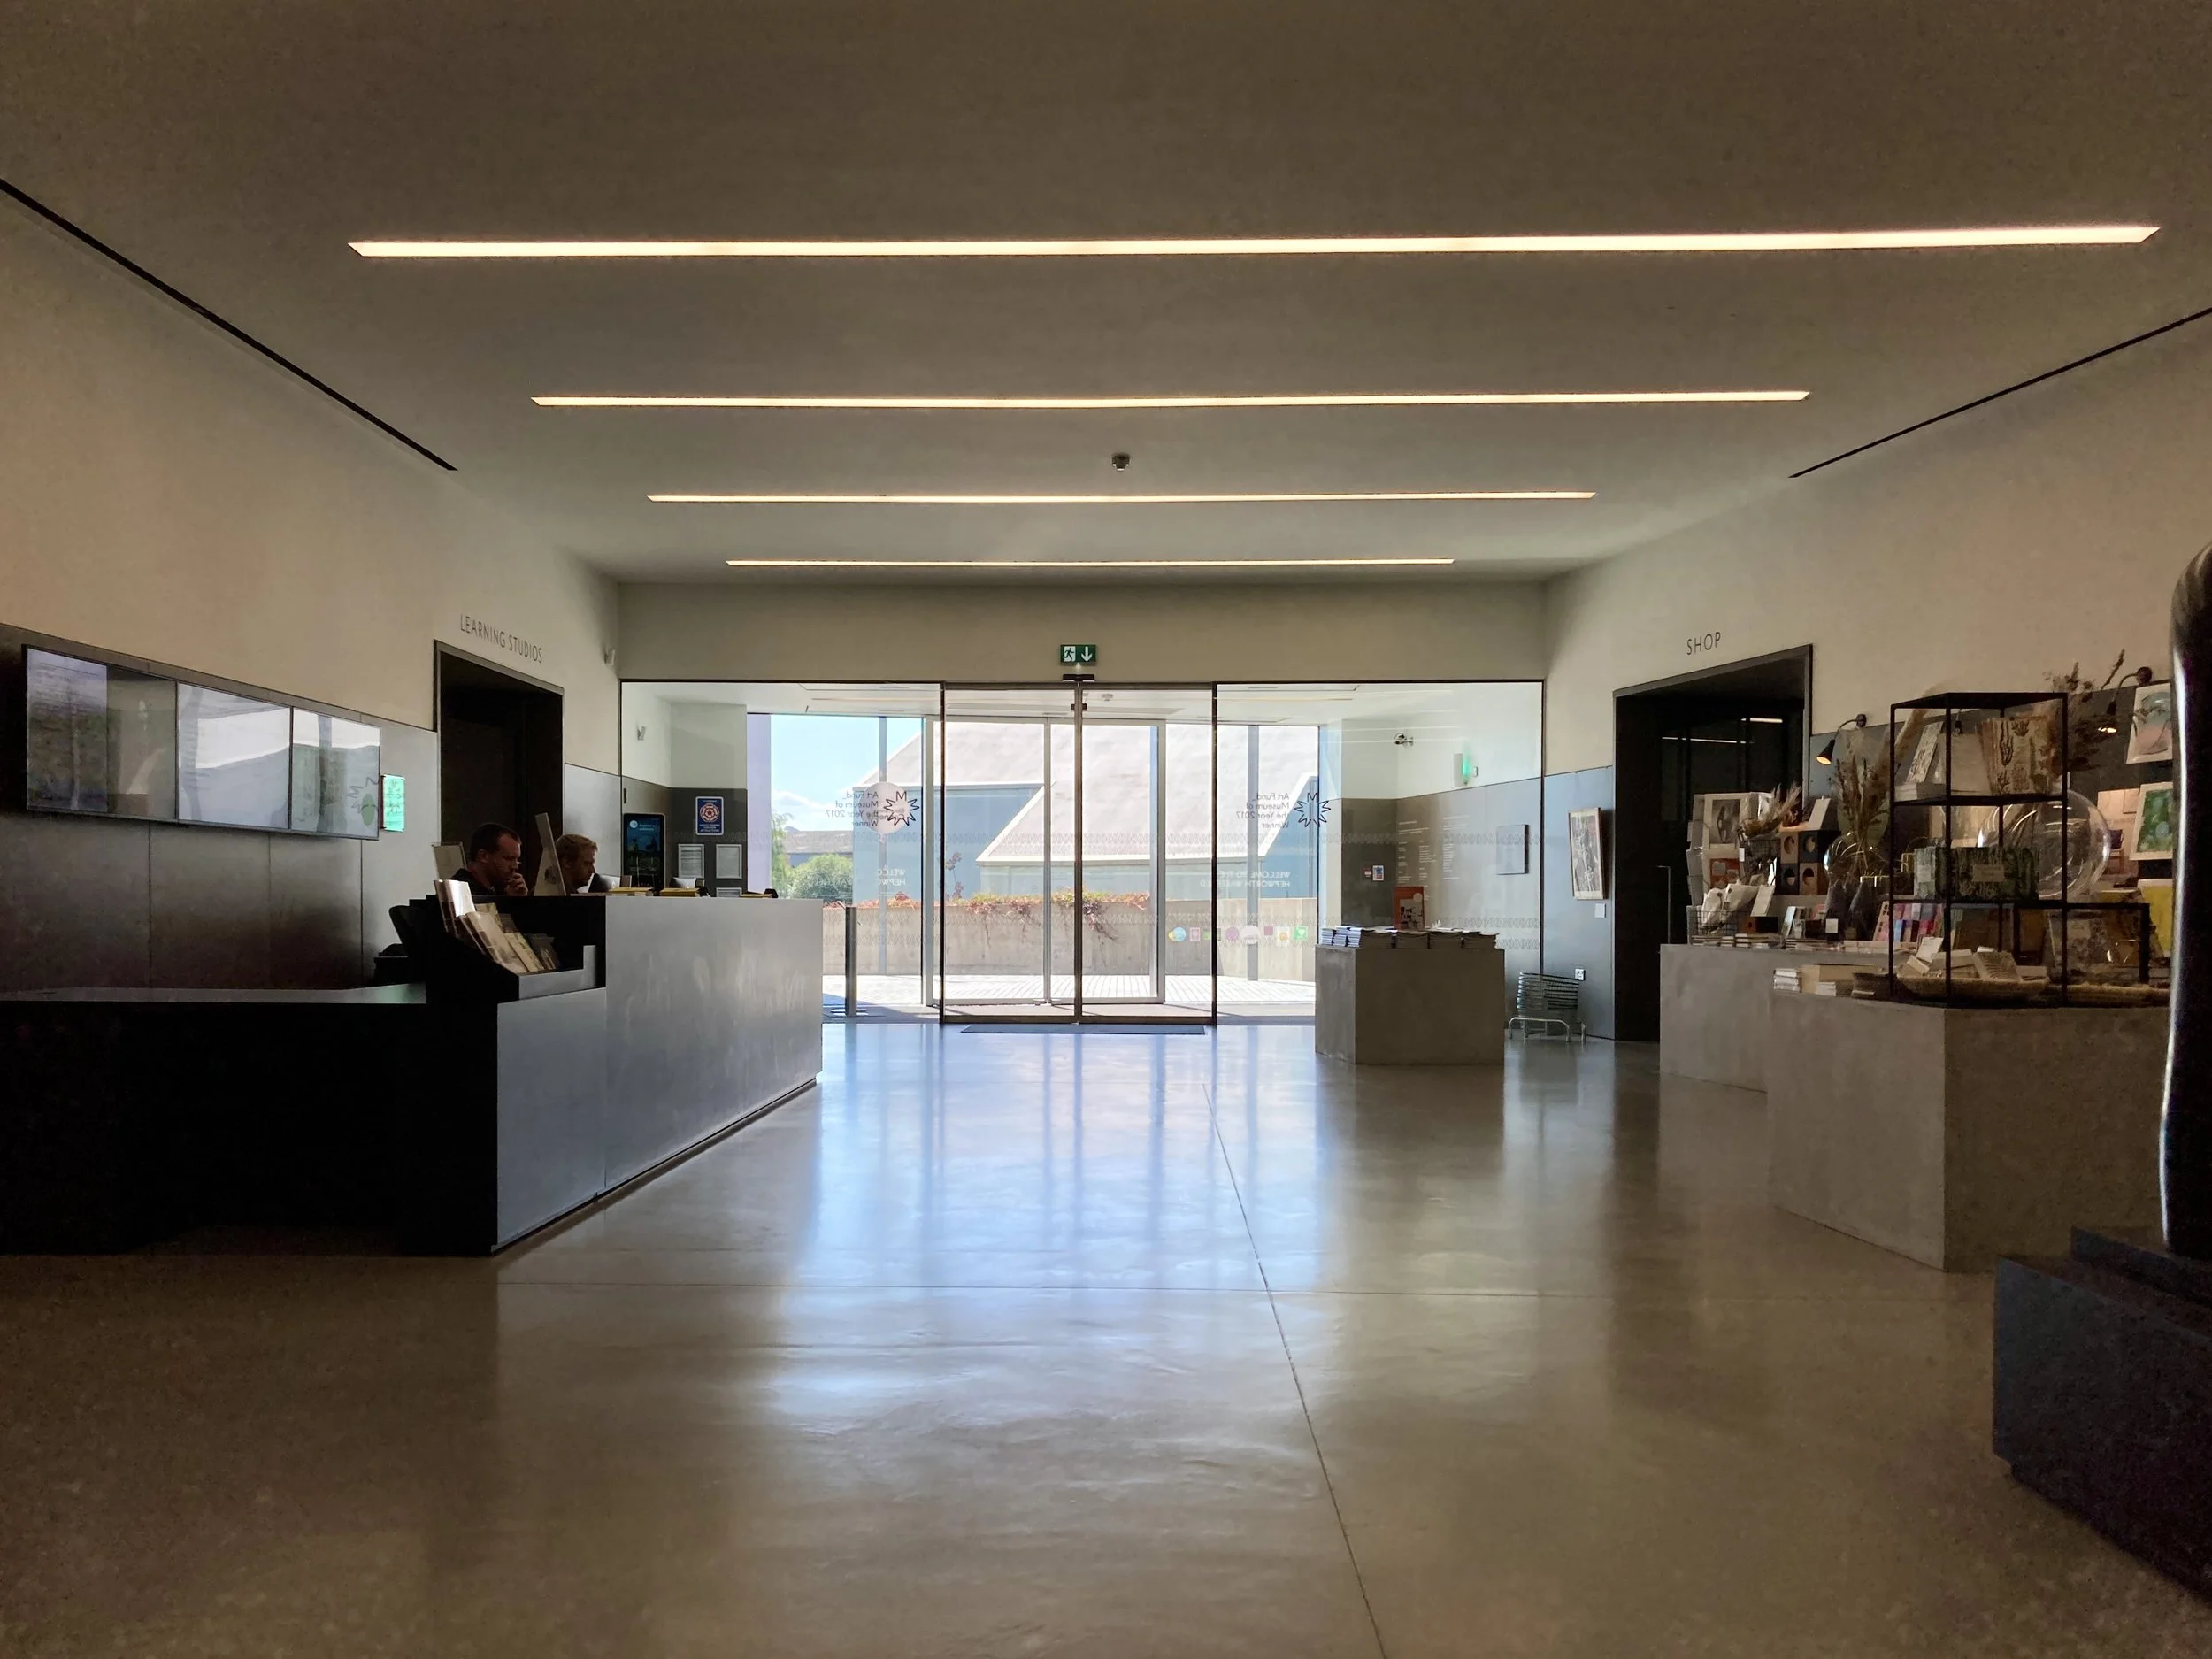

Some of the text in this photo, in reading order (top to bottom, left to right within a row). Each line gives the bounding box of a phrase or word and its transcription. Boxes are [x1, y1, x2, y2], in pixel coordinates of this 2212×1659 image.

[460, 613, 542, 664] LEARNING STUDIOS
[1686, 631, 1721, 655] SHOP
